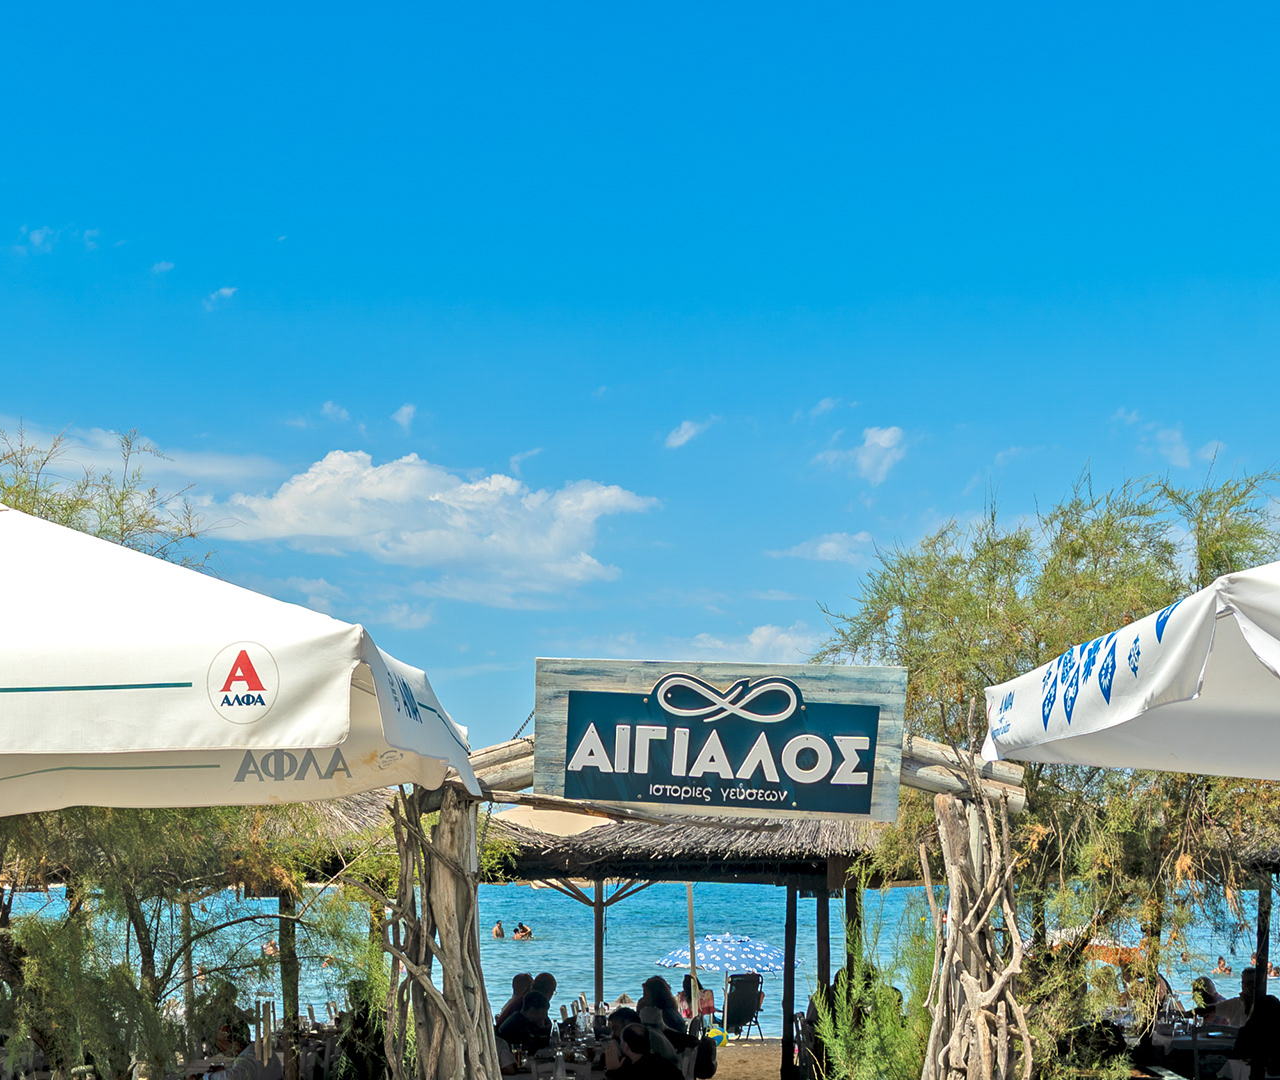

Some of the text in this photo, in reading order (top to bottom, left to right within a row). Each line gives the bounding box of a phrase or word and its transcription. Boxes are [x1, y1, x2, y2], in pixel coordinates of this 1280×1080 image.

[220, 693, 266, 707] ΑΛΦΑ
[567, 722, 870, 785] ΑΙΓΙΑΛΟΣ
[720, 783, 788, 802] γεύσεων
